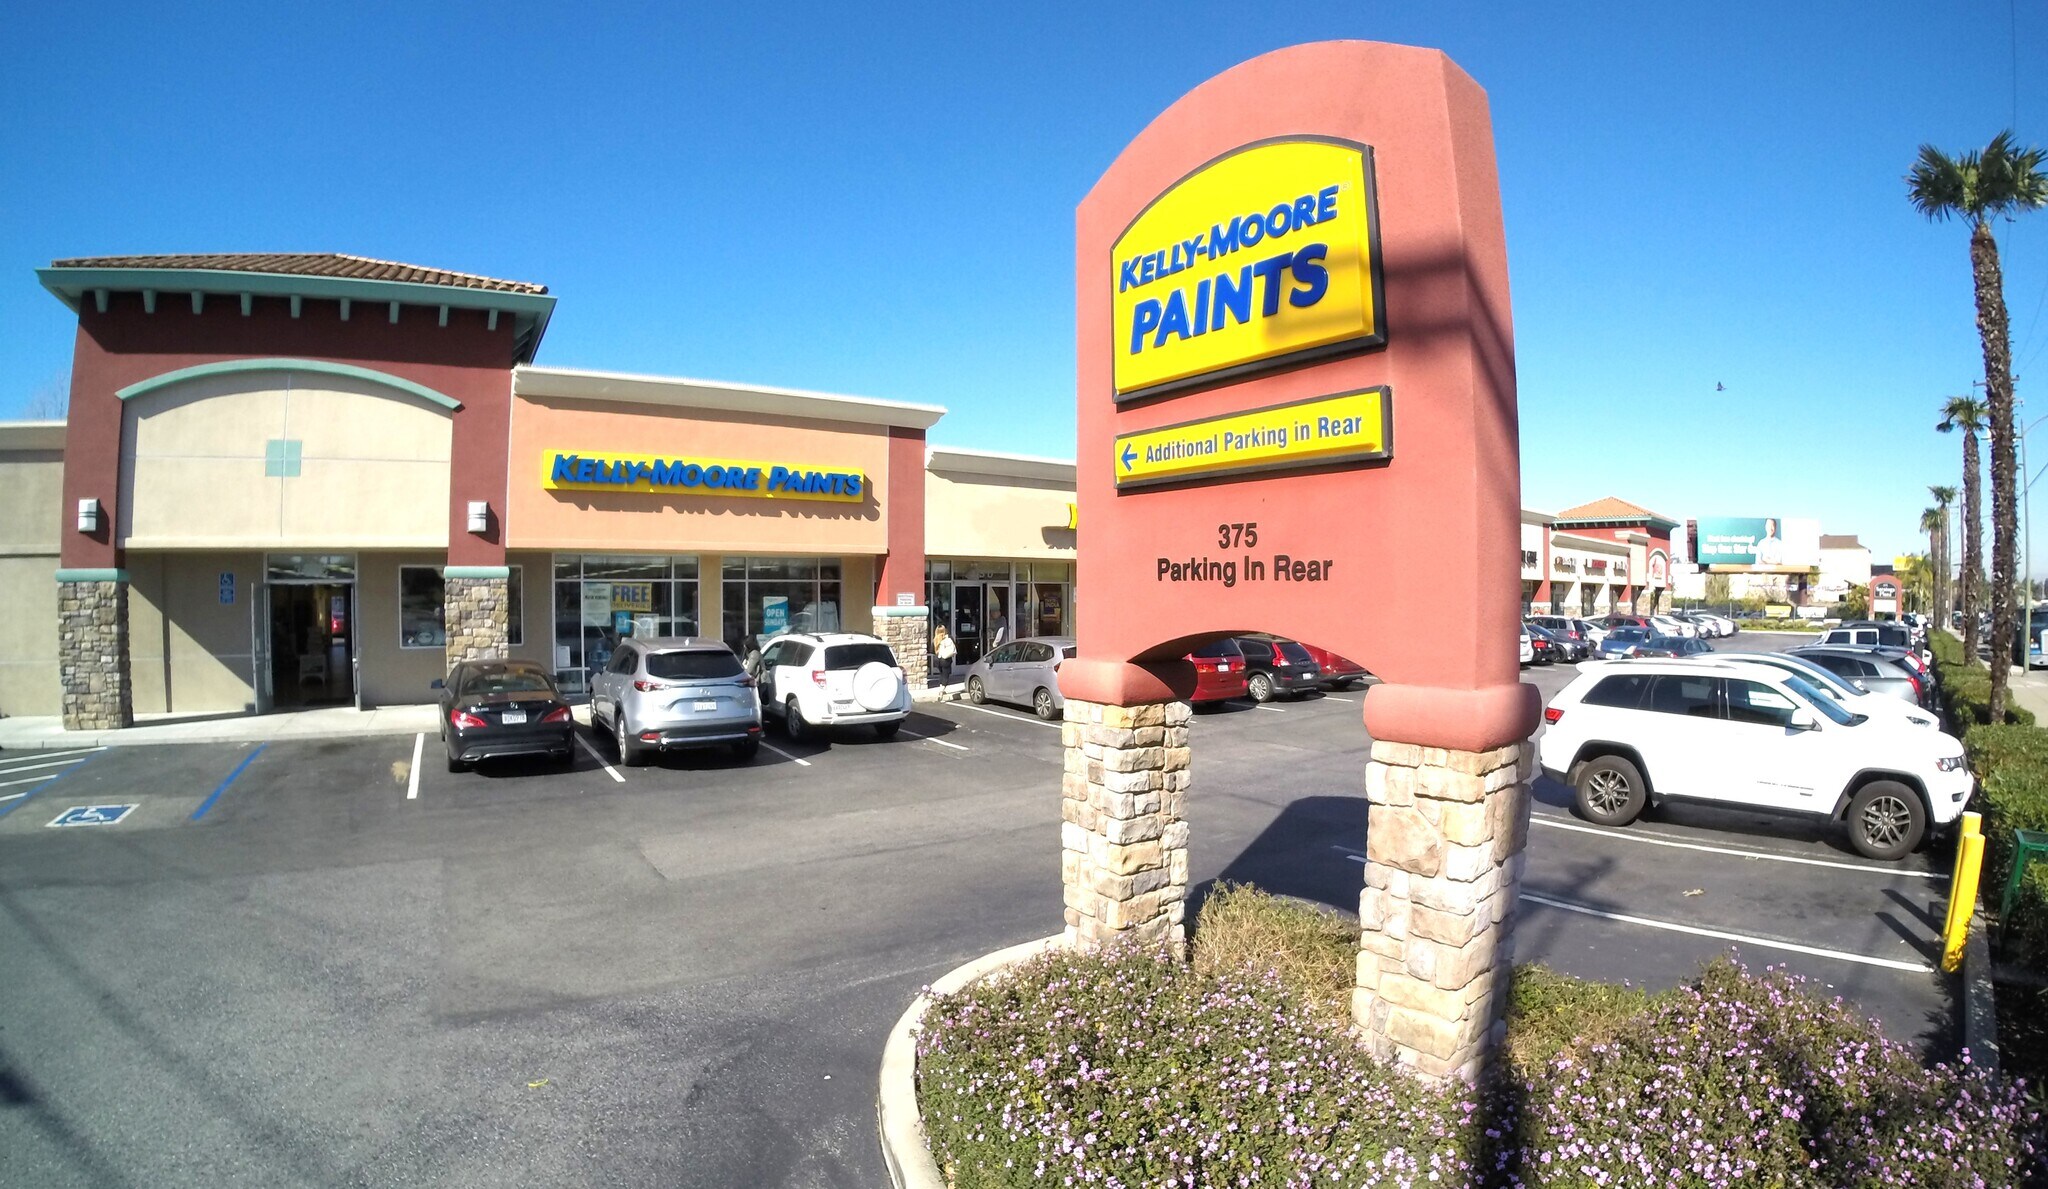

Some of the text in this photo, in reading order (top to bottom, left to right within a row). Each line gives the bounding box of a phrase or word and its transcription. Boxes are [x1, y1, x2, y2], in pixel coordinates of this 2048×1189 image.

[1119, 185, 1339, 293] KELLY-MOORE
[1130, 243, 1329, 355] PAINTS
[1146, 416, 1362, 463] Additional Parking in Rear
[551, 454, 862, 496] KELLY-MOORE PAINTS
[1218, 522, 1259, 549] 375
[1157, 554, 1333, 588] Parking In Rear
[612, 586, 650, 602] FREE
[766, 608, 785, 617] OPEN
